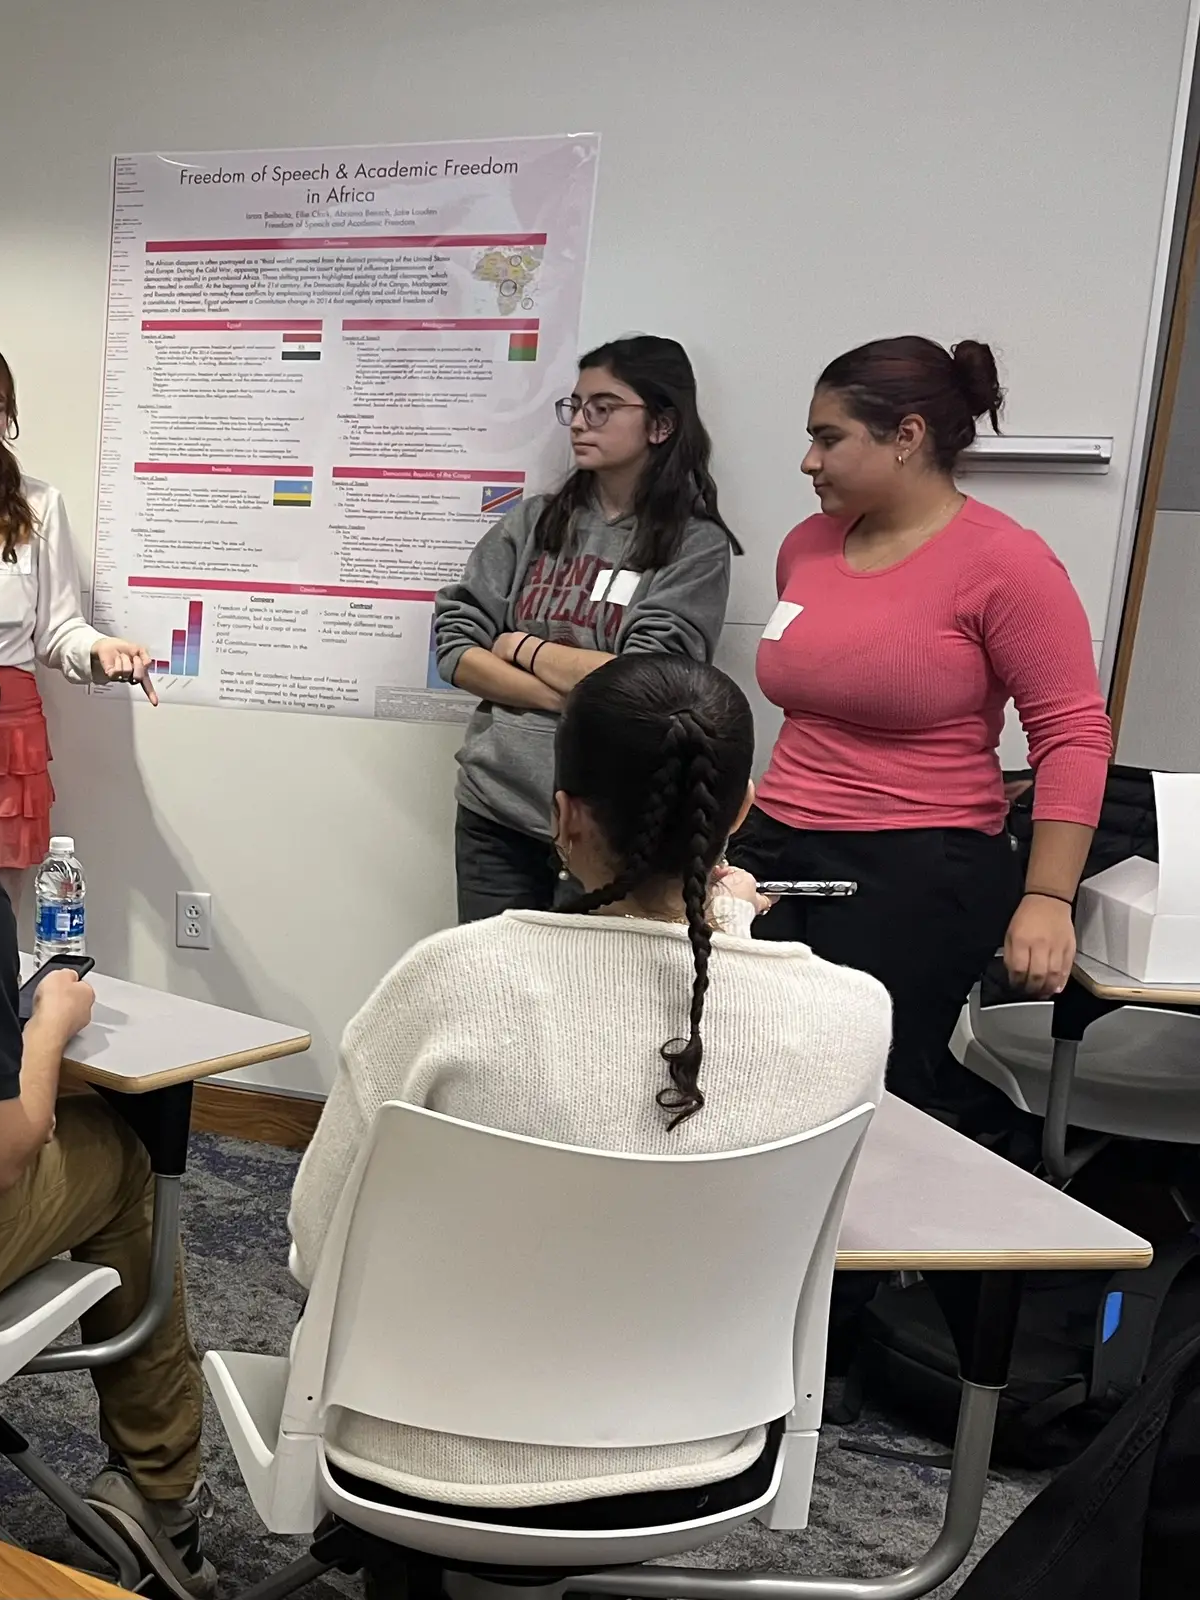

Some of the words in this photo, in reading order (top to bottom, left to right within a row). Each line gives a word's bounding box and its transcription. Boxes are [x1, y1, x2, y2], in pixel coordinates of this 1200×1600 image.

[179, 167, 245, 183] Freedom
[250, 166, 267, 181] of
[271, 164, 329, 185] Speech
[335, 163, 348, 179] &
[354, 161, 437, 177] Academic
[443, 158, 518, 175] Freedom
[306, 190, 319, 203] in
[325, 186, 375, 203] Africa
